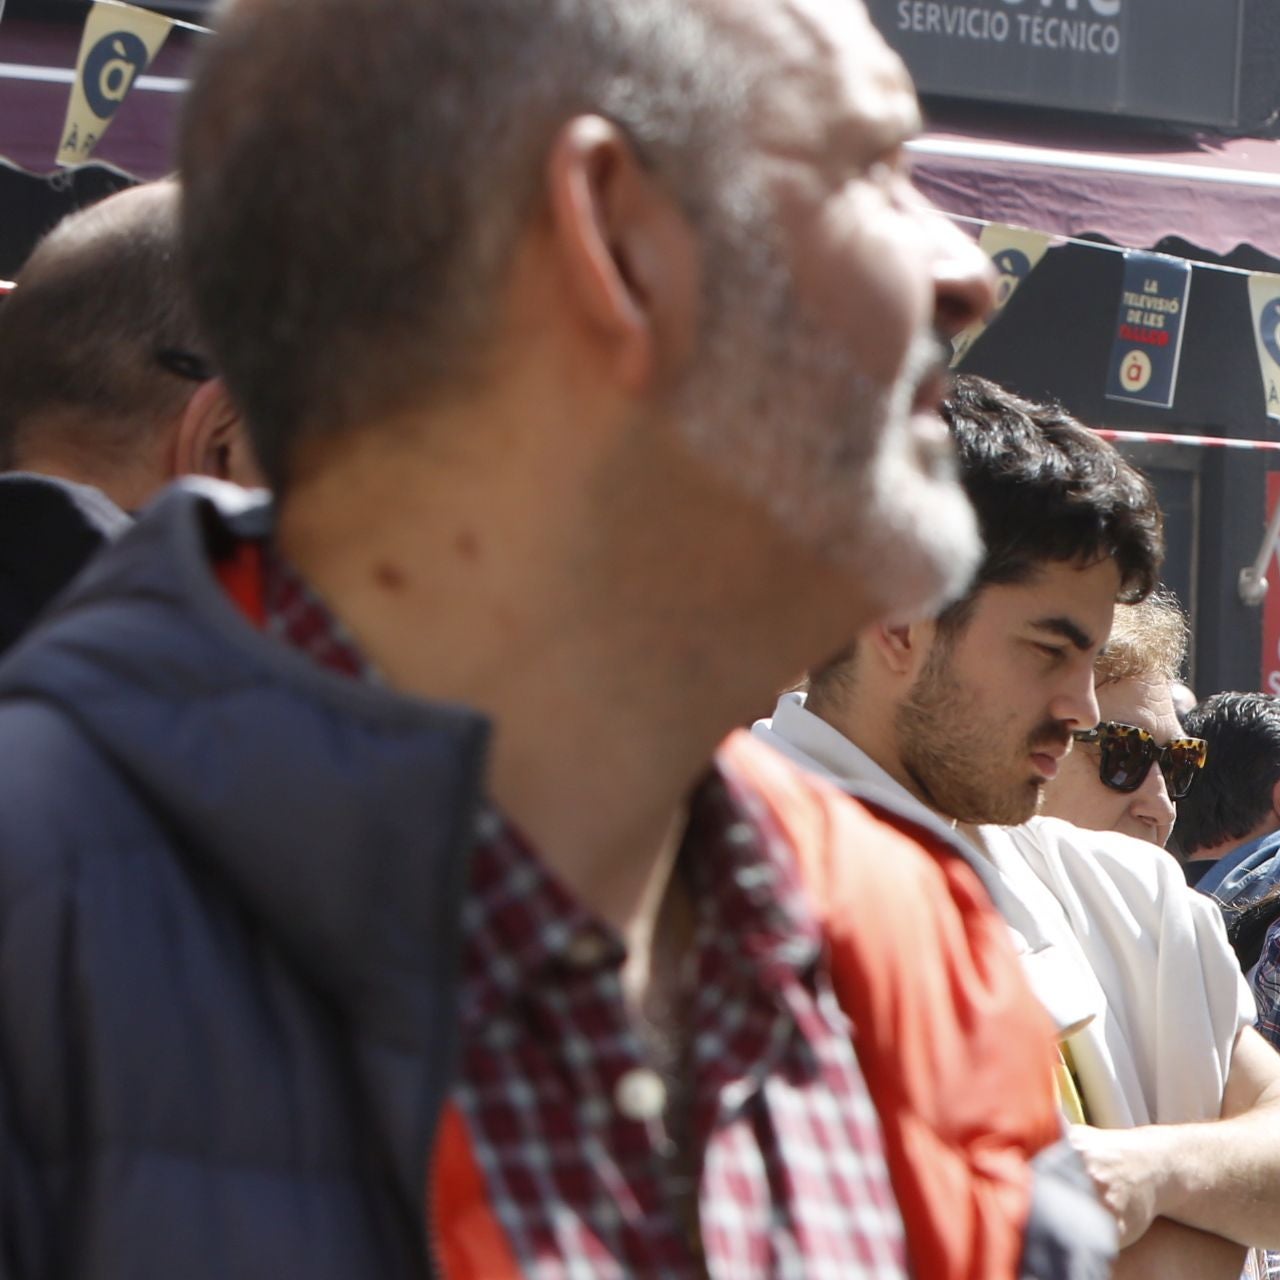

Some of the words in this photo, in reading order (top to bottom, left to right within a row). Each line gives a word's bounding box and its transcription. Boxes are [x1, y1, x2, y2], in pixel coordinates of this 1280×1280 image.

[897, 1, 1009, 42] SERVICIO
[1144, 278, 1158, 293] LA
[1123, 291, 1179, 314] TELEVISIÓ
[1126, 309, 1144, 323] DE
[1143, 312, 1165, 328] LES
